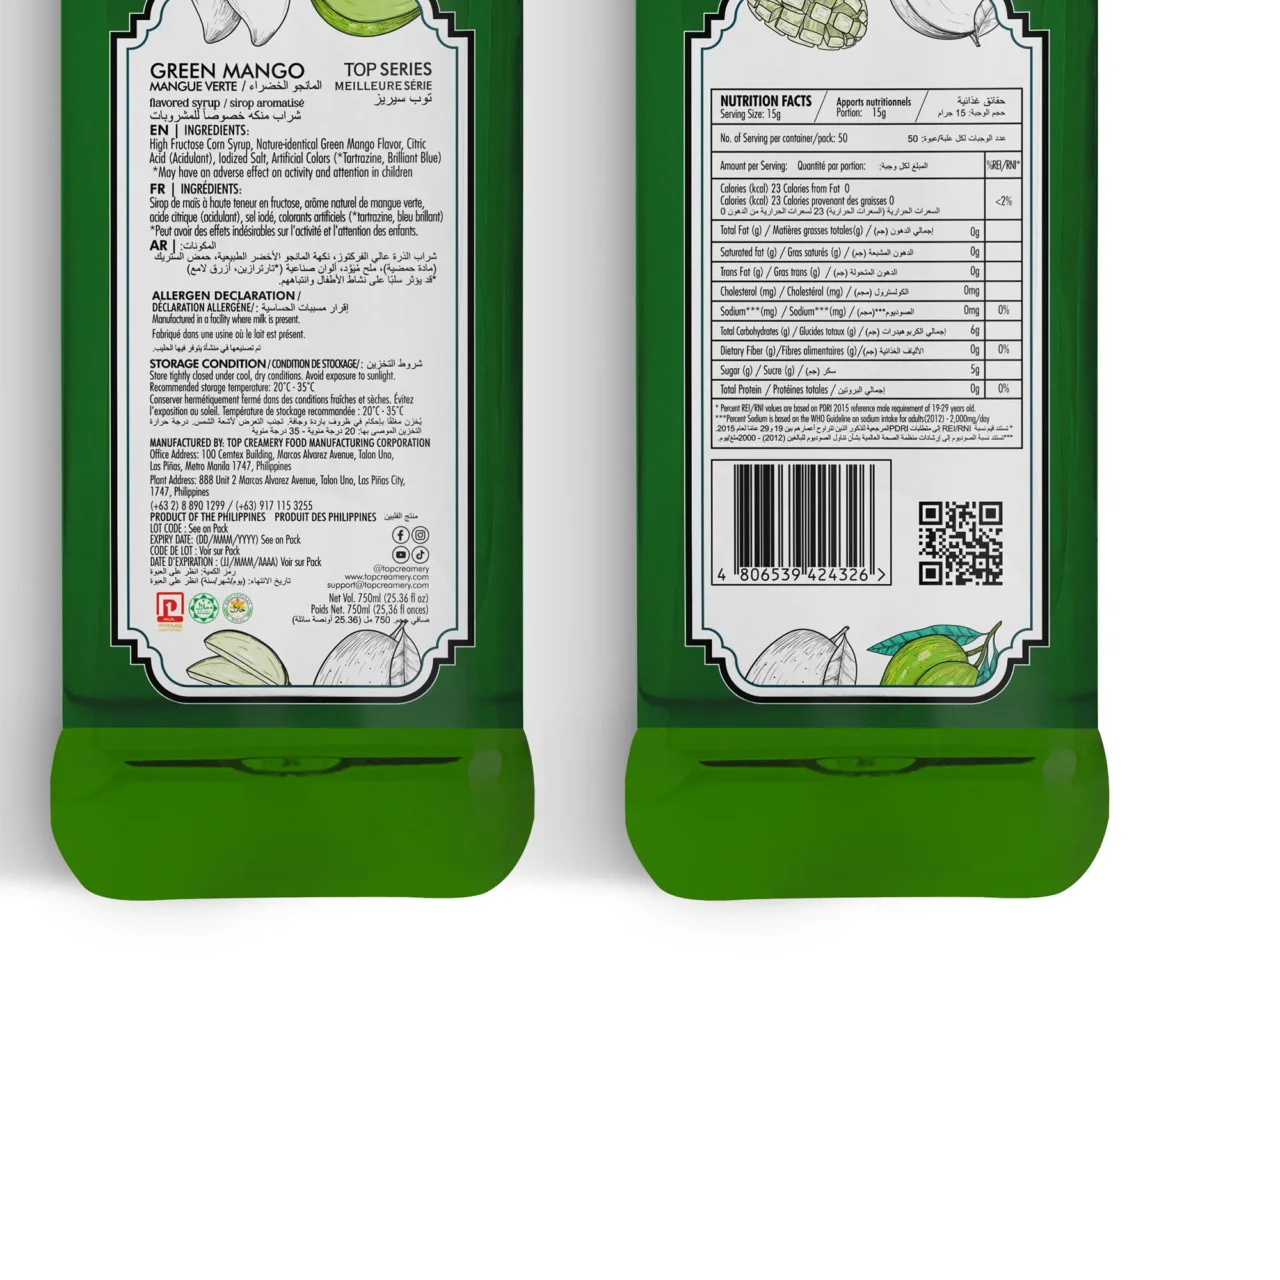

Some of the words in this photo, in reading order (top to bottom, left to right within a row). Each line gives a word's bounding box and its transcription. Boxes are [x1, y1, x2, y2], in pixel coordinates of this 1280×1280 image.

[150, 62, 216, 79] GREEN
[222, 62, 305, 79] MANGO
[343, 62, 377, 77] TOP
[380, 61, 432, 77] SERIES
[149, 81, 203, 92] MANGUE
[204, 81, 238, 92] VERTE
[249, 79, 289, 93] الخضراء
[292, 79, 322, 93] المانجو
[335, 81, 402, 91] MEILLEURE
[404, 79, 432, 91] SÉRIE
[149, 97, 189, 108] flavored
[191, 99, 221, 109] syrup
[229, 98, 255, 109] sirop
[256, 98, 305, 108] aromatisé
[374, 93, 406, 106] سيريز
[409, 92, 432, 106] توب
[720, 94, 779, 107] NUTRITION
[781, 94, 812, 107] FACTS
[836, 97, 864, 108] Apports
[866, 96, 912, 108] nutritionnels
[720, 108, 746, 121] Serving
[747, 108, 765, 119] Size:
[767, 108, 781, 121] 15g
[836, 107, 862, 118] Portion:
[873, 107, 886, 120] 15g
[150, 124, 169, 136] EN
[184, 124, 249, 136] INGREDIENTS:
[720, 133, 732, 143] No.
[734, 132, 741, 143] of
[743, 132, 768, 145] Serving
[770, 135, 781, 145] per
[782, 132, 836, 145] container/pack:
[838, 132, 848, 143] 50
[149, 138, 168, 152] High
[170, 138, 204, 152] Fructose
[206, 138, 225, 150] Corn
[227, 138, 254, 152] Syrup,
[256, 138, 318, 152] Nature-identical
[320, 138, 344, 150] Green
[346, 138, 375, 152] Mango
[377, 138, 404, 152] Flavor,
[406, 138, 428, 152] Citric
[149, 152, 166, 164] Acid
[169, 152, 216, 165] (Acidulant),
[218, 152, 248, 164] Iodized
[250, 152, 269, 165] Salt,
[271, 152, 304, 164] Artificial
[306, 152, 331, 164] Colors
[387, 152, 418, 164] Brilliant
[420, 152, 442, 164] Blue)
[720, 160, 746, 171] Amount
[748, 163, 759, 172] per
[760, 160, 788, 173] Serving:
[797, 160, 826, 171] Quantité
[827, 163, 839, 173] par
[840, 161, 866, 173] portion:
[178, 166, 198, 178] have
[200, 169, 211, 178] an
[213, 166, 244, 178] adverse
[246, 166, 270, 178] effect
[271, 169, 282, 178] on
[284, 166, 313, 180] activity
[315, 166, 331, 178] and
[333, 166, 369, 178] attention
[371, 166, 379, 177] in
[381, 166, 413, 178] children
[150, 183, 166, 195] FR
[181, 181, 242, 195] INGRÉDIENTS:
[720, 183, 747, 194] Calories
[749, 183, 769, 194] (kcal)
[771, 183, 781, 194] 23
[783, 183, 810, 194] Calories
[811, 183, 827, 194] from
[829, 183, 840, 193] Fat
[844, 183, 850, 194] 0
[995, 195, 1012, 206] <2%
[151, 290, 210, 301] ALLERGEN
[214, 290, 295, 301] DECLARATION
[149, 358, 199, 369] STORAGE
[201, 358, 266, 369] CONDITION
[720, 384, 737, 395] Total
[738, 384, 762, 395] Protein
[773, 384, 804, 395] Protéines
[805, 384, 829, 395] totales
[149, 438, 212, 448] MANUFACTURED
[213, 438, 225, 448] BY:
[226, 438, 242, 448] TOP
[244, 438, 284, 448] CREAMERY
[285, 438, 307, 448] FOOD
[309, 438, 375, 448] MANUFACTURING
[376, 438, 431, 448] CORPORATION
[150, 512, 187, 522] PRODUCT
[188, 512, 199, 522] OF
[200, 512, 216, 522] THE
[217, 512, 266, 522] PHILIPPINES
[274, 512, 310, 522] PRODUIT
[311, 512, 327, 522] DES
[328, 512, 377, 522] PHILIPPINES
[373, 564, 429, 574] @topcreamery
[717, 568, 726, 581] 4
[740, 568, 801, 582] 806539
[807, 568, 870, 582] 424326
[344, 573, 429, 581] www.topcreamery.com
[327, 581, 429, 590] support@topcreamery.com
[329, 593, 341, 603] Net
[342, 592, 356, 603] Vol.
[358, 592, 381, 603] 750ml
[384, 593, 409, 604] (25.36
[410, 592, 416, 603] fl
[417, 593, 429, 604] oz)
